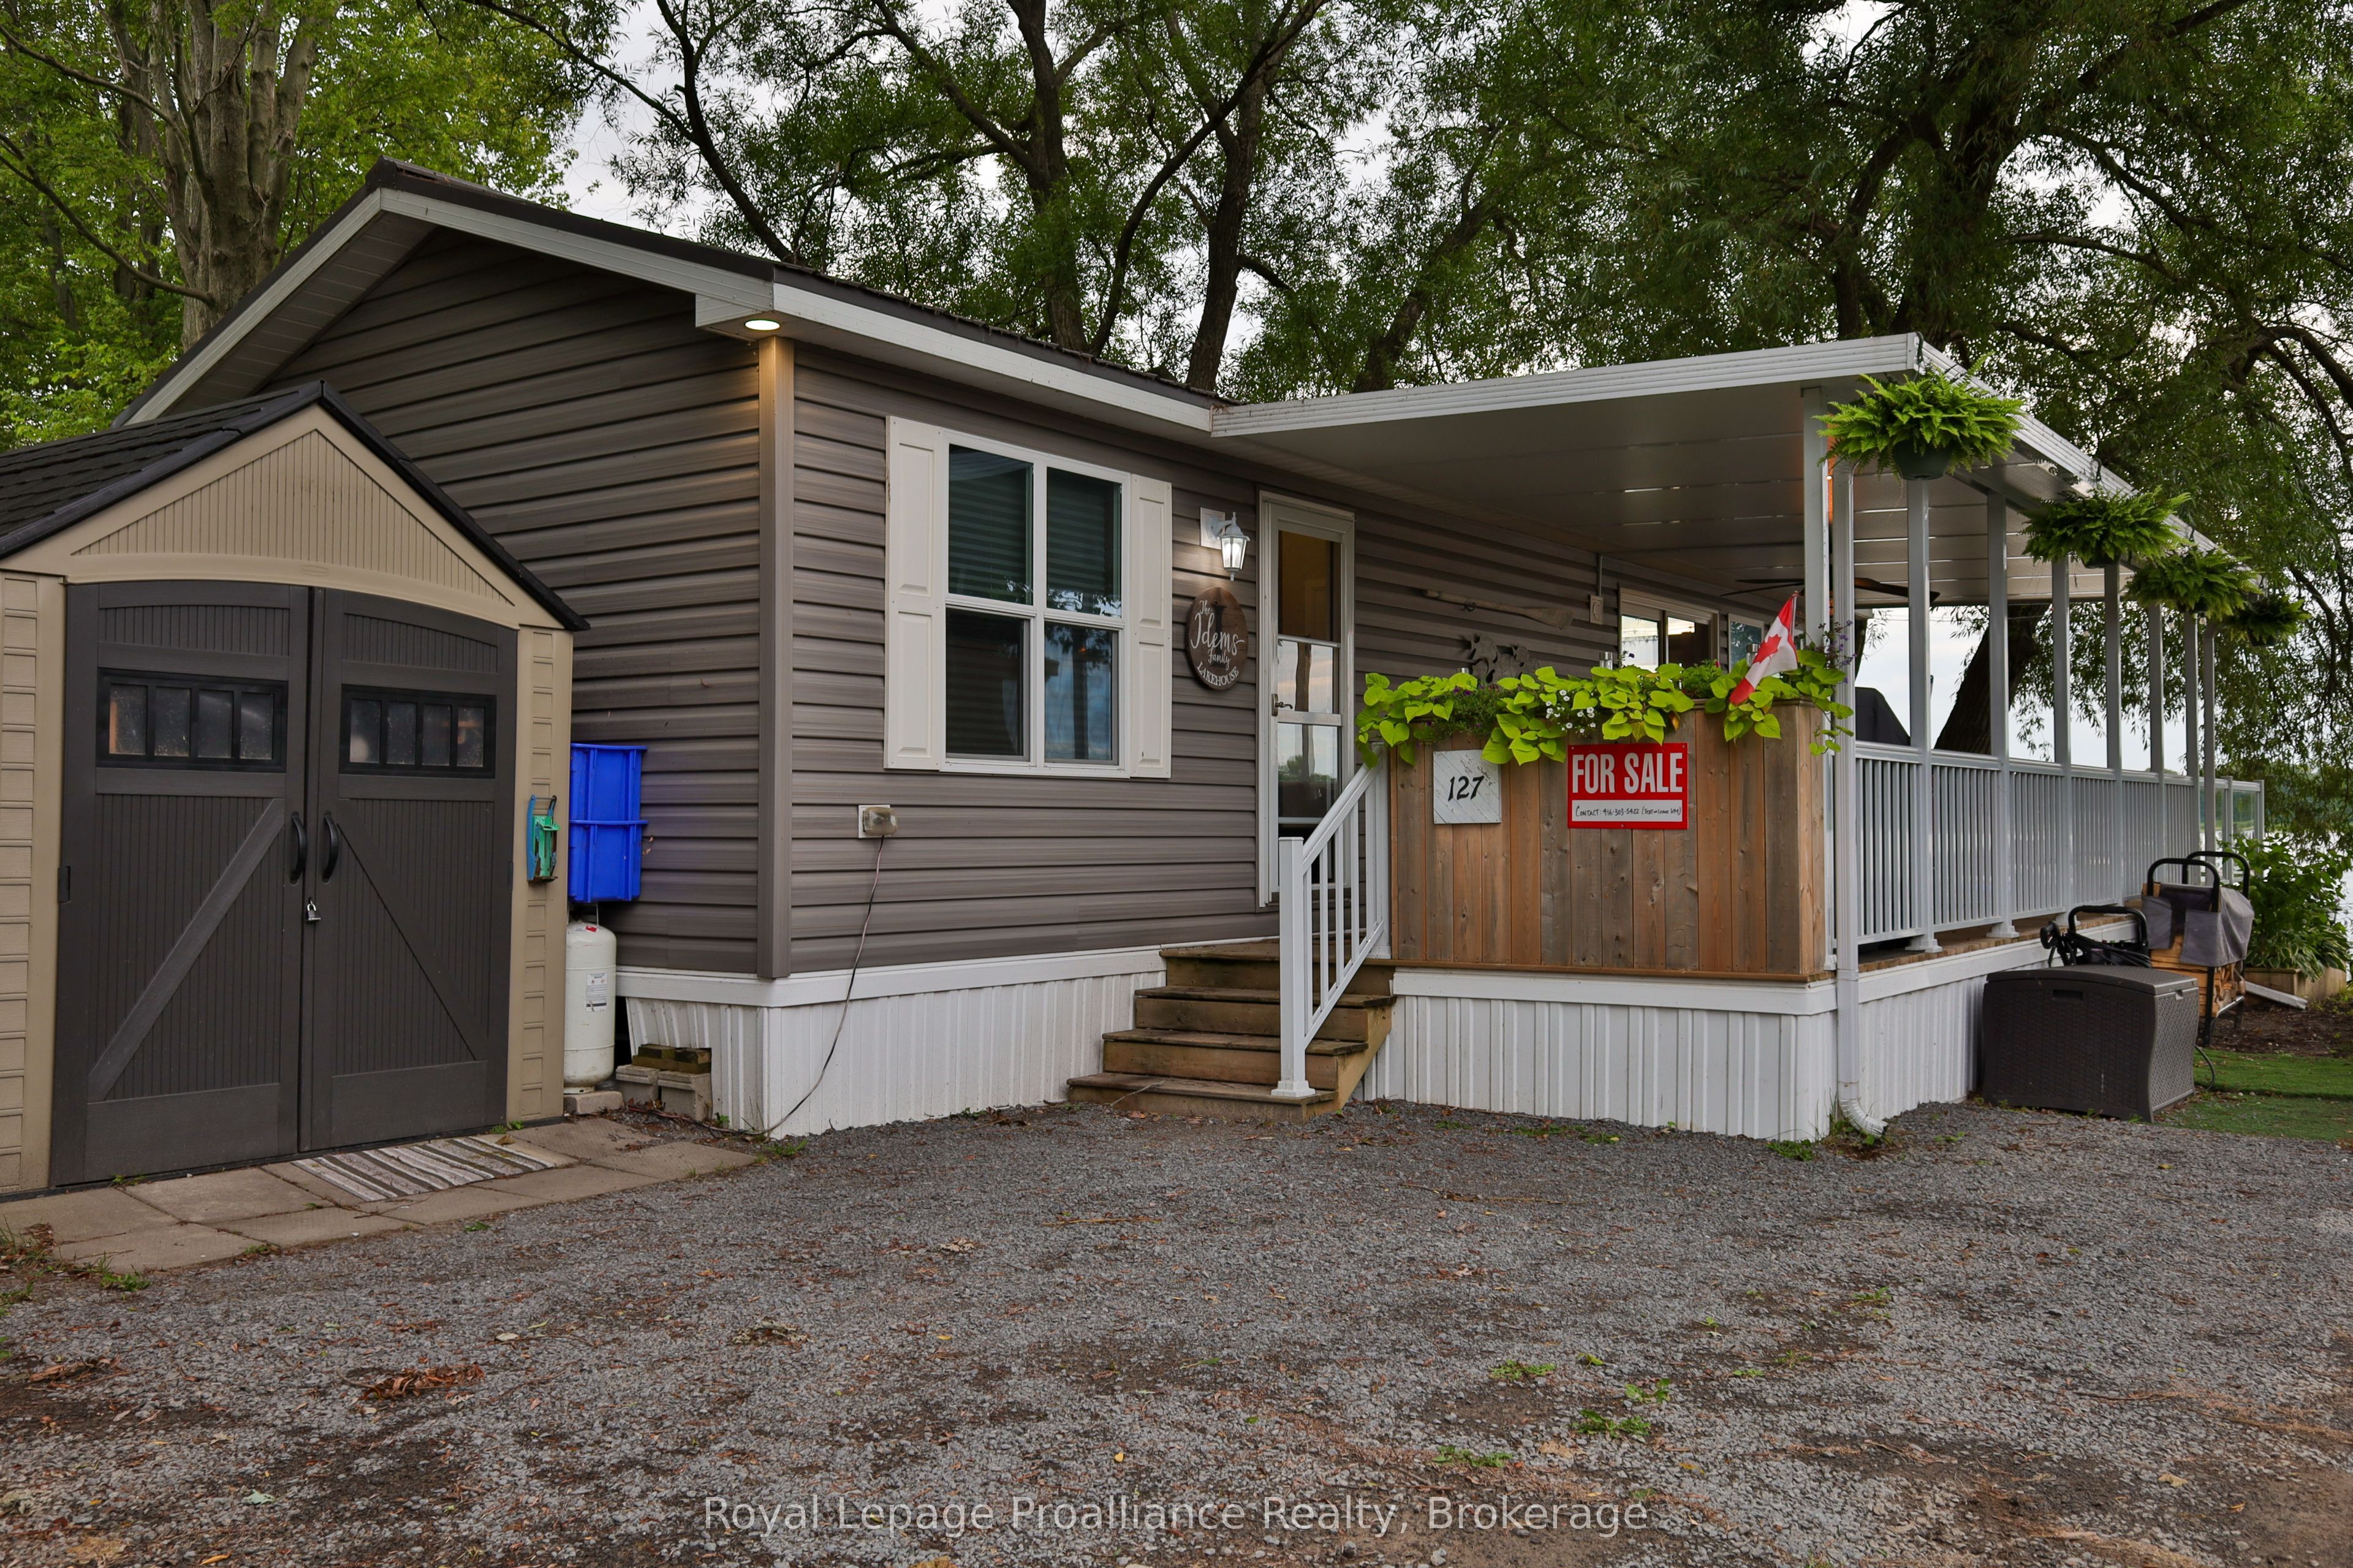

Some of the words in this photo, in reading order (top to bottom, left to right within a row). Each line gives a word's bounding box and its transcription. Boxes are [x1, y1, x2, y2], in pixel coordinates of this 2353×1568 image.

[1199, 600, 1213, 615] The
[1208, 648, 1230, 670] Family
[1197, 661, 1239, 686] LAKEHOUSE
[1572, 753, 1615, 793] FOR
[1624, 752, 1683, 793] SALE
[1448, 775, 1485, 801] 127
